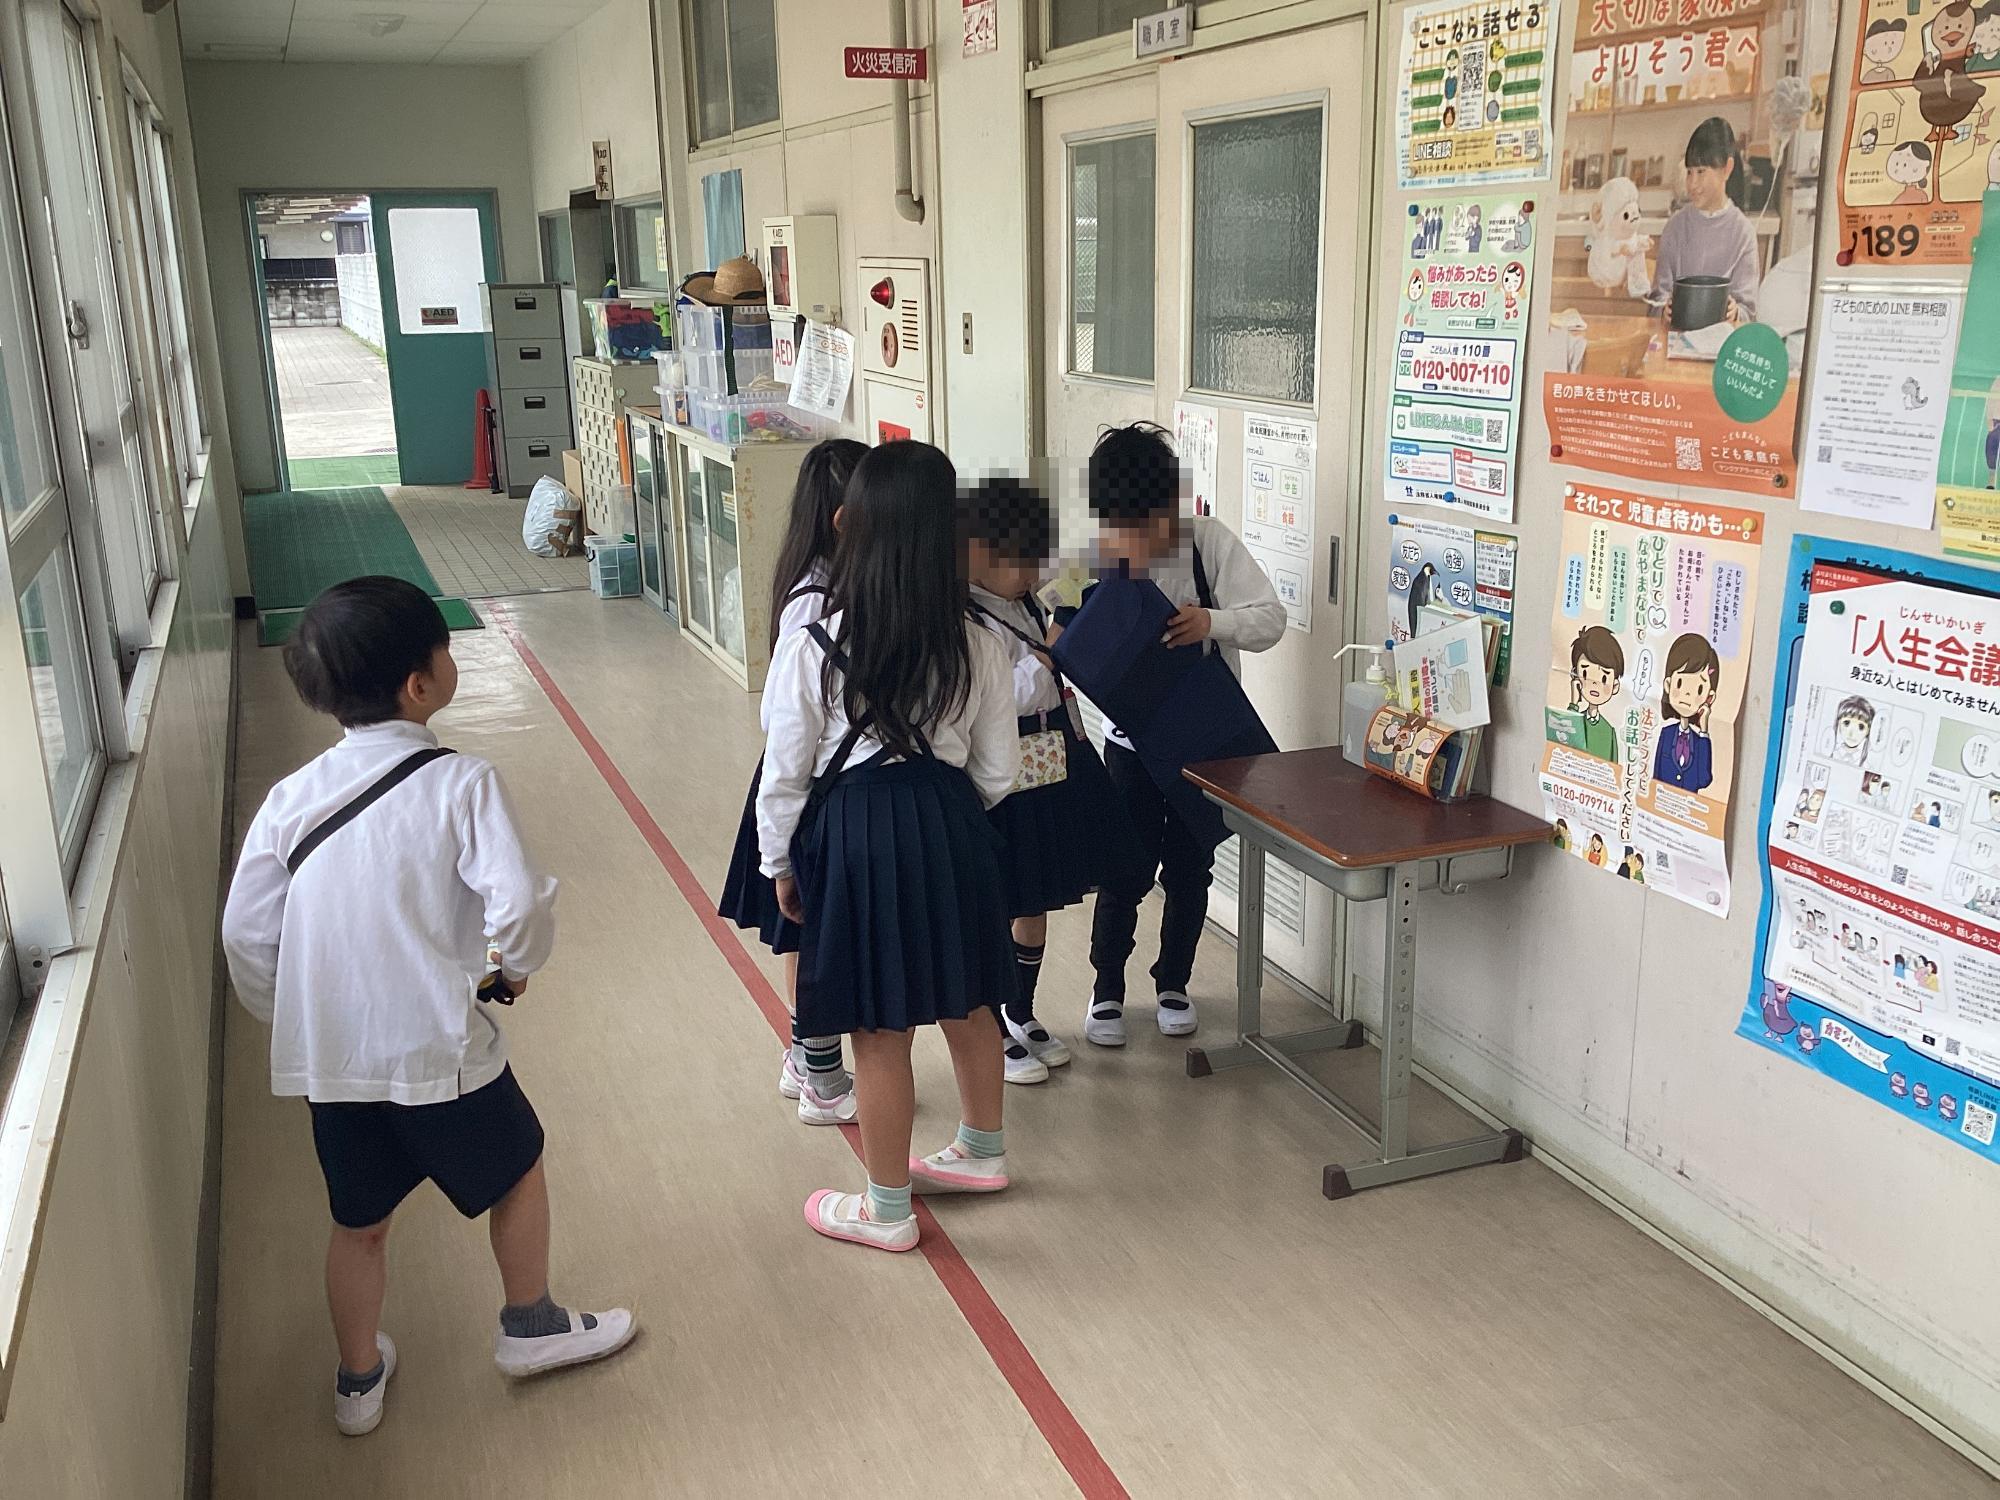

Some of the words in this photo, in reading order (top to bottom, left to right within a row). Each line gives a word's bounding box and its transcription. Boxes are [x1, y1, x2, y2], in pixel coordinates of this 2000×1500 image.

[1419, 4, 1540, 48] ここなら話せる
[1592, 0, 1747, 33] 大切な家
[1142, 17, 1181, 46] 職員室
[852, 52, 917, 75] 火災受信所
[1592, 31, 1757, 83] よりそう君へ
[1413, 140, 1453, 161] LINE相談
[1861, 224, 1920, 257] 189
[1427, 264, 1497, 283] 悩みがあったら
[432, 308, 455, 317] AED
[1833, 299, 1889, 315] 子どものための
[1890, 303, 1910, 315] LINE
[1912, 302, 1948, 317] 無料相談
[774, 338, 793, 366] AED
[1430, 344, 1459, 356] こどもの人権
[1723, 359, 1778, 390] だれかに話して
[1726, 376, 1765, 400] いいんだよ
[1552, 383, 1682, 411] 君の声をきかせてほしい。
[1711, 446, 1781, 465] こども家庭庁
[1253, 471, 1270, 484] ごはん
[1574, 491, 1624, 518] それって
[1402, 546, 1420, 562] 友だち
[1445, 551, 1463, 571] 勉強
[1695, 551, 1703, 581] 目の前で
[1391, 569, 1409, 588] 家族
[1651, 535, 1667, 604] ひとりで
[1676, 548, 1685, 601] たたかれている
[1815, 579, 1838, 588] できること
[1280, 586, 1296, 601] 牛乳
[1453, 584, 1471, 603] 学校
[1635, 538, 1649, 641] なやまないで
[1713, 566, 1723, 643] ひどいことを言われる
[1899, 605, 1987, 635] じんせいかいぎ
[1851, 614, 2000, 687] 「人生会議
[1428, 658, 1440, 714] お願いします
[1640, 706, 1654, 791] 法テラスに
[1620, 709, 1640, 840] お話ししてください
[1553, 784, 1615, 815] 0120-079714
